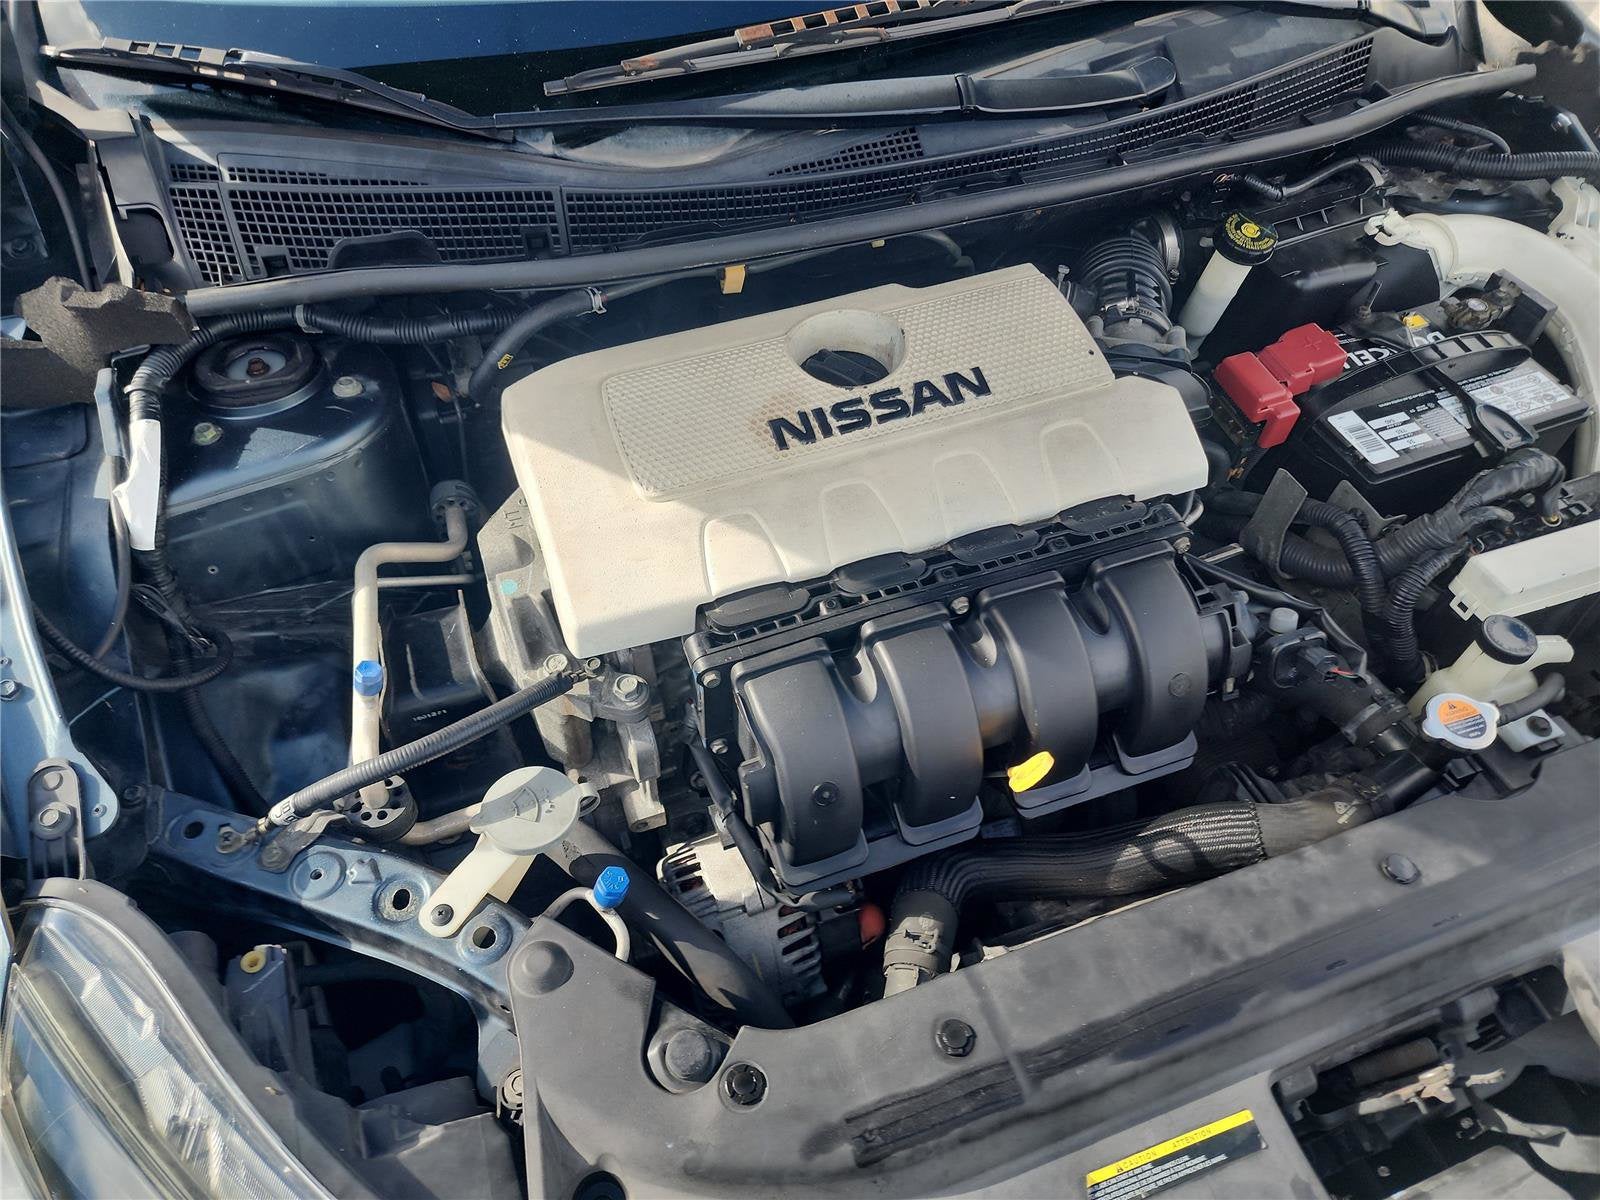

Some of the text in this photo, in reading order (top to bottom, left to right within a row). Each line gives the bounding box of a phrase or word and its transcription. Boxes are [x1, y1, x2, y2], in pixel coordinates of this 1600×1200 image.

[767, 366, 992, 451] NISSAN
[1124, 1128, 1212, 1169] CAUTION ATTENTION
